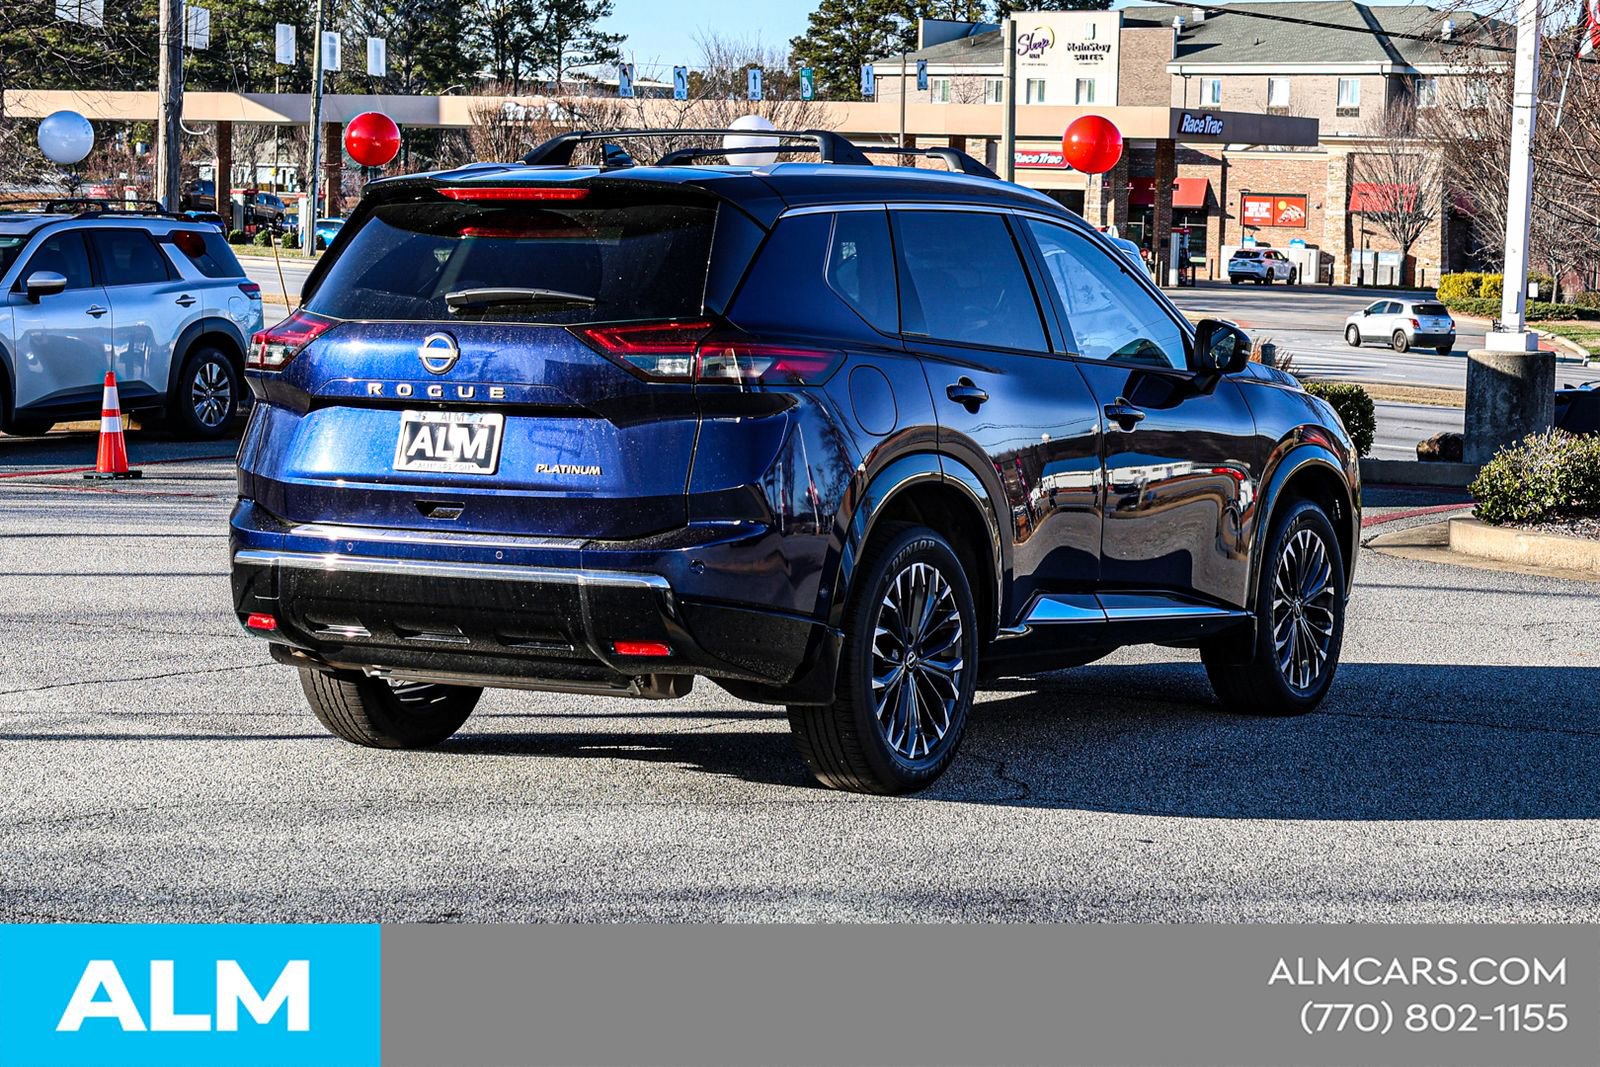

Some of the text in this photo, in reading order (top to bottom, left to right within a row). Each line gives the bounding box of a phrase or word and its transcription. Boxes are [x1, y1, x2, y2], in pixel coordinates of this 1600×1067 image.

[1017, 32, 1050, 56] Sleep
[1067, 42, 1111, 53] MainStay
[367, 382, 508, 399] ROGUE
[406, 425, 489, 460] ALM
[535, 463, 603, 475] PLATINUM
[892, 540, 936, 571] DUNLOP
